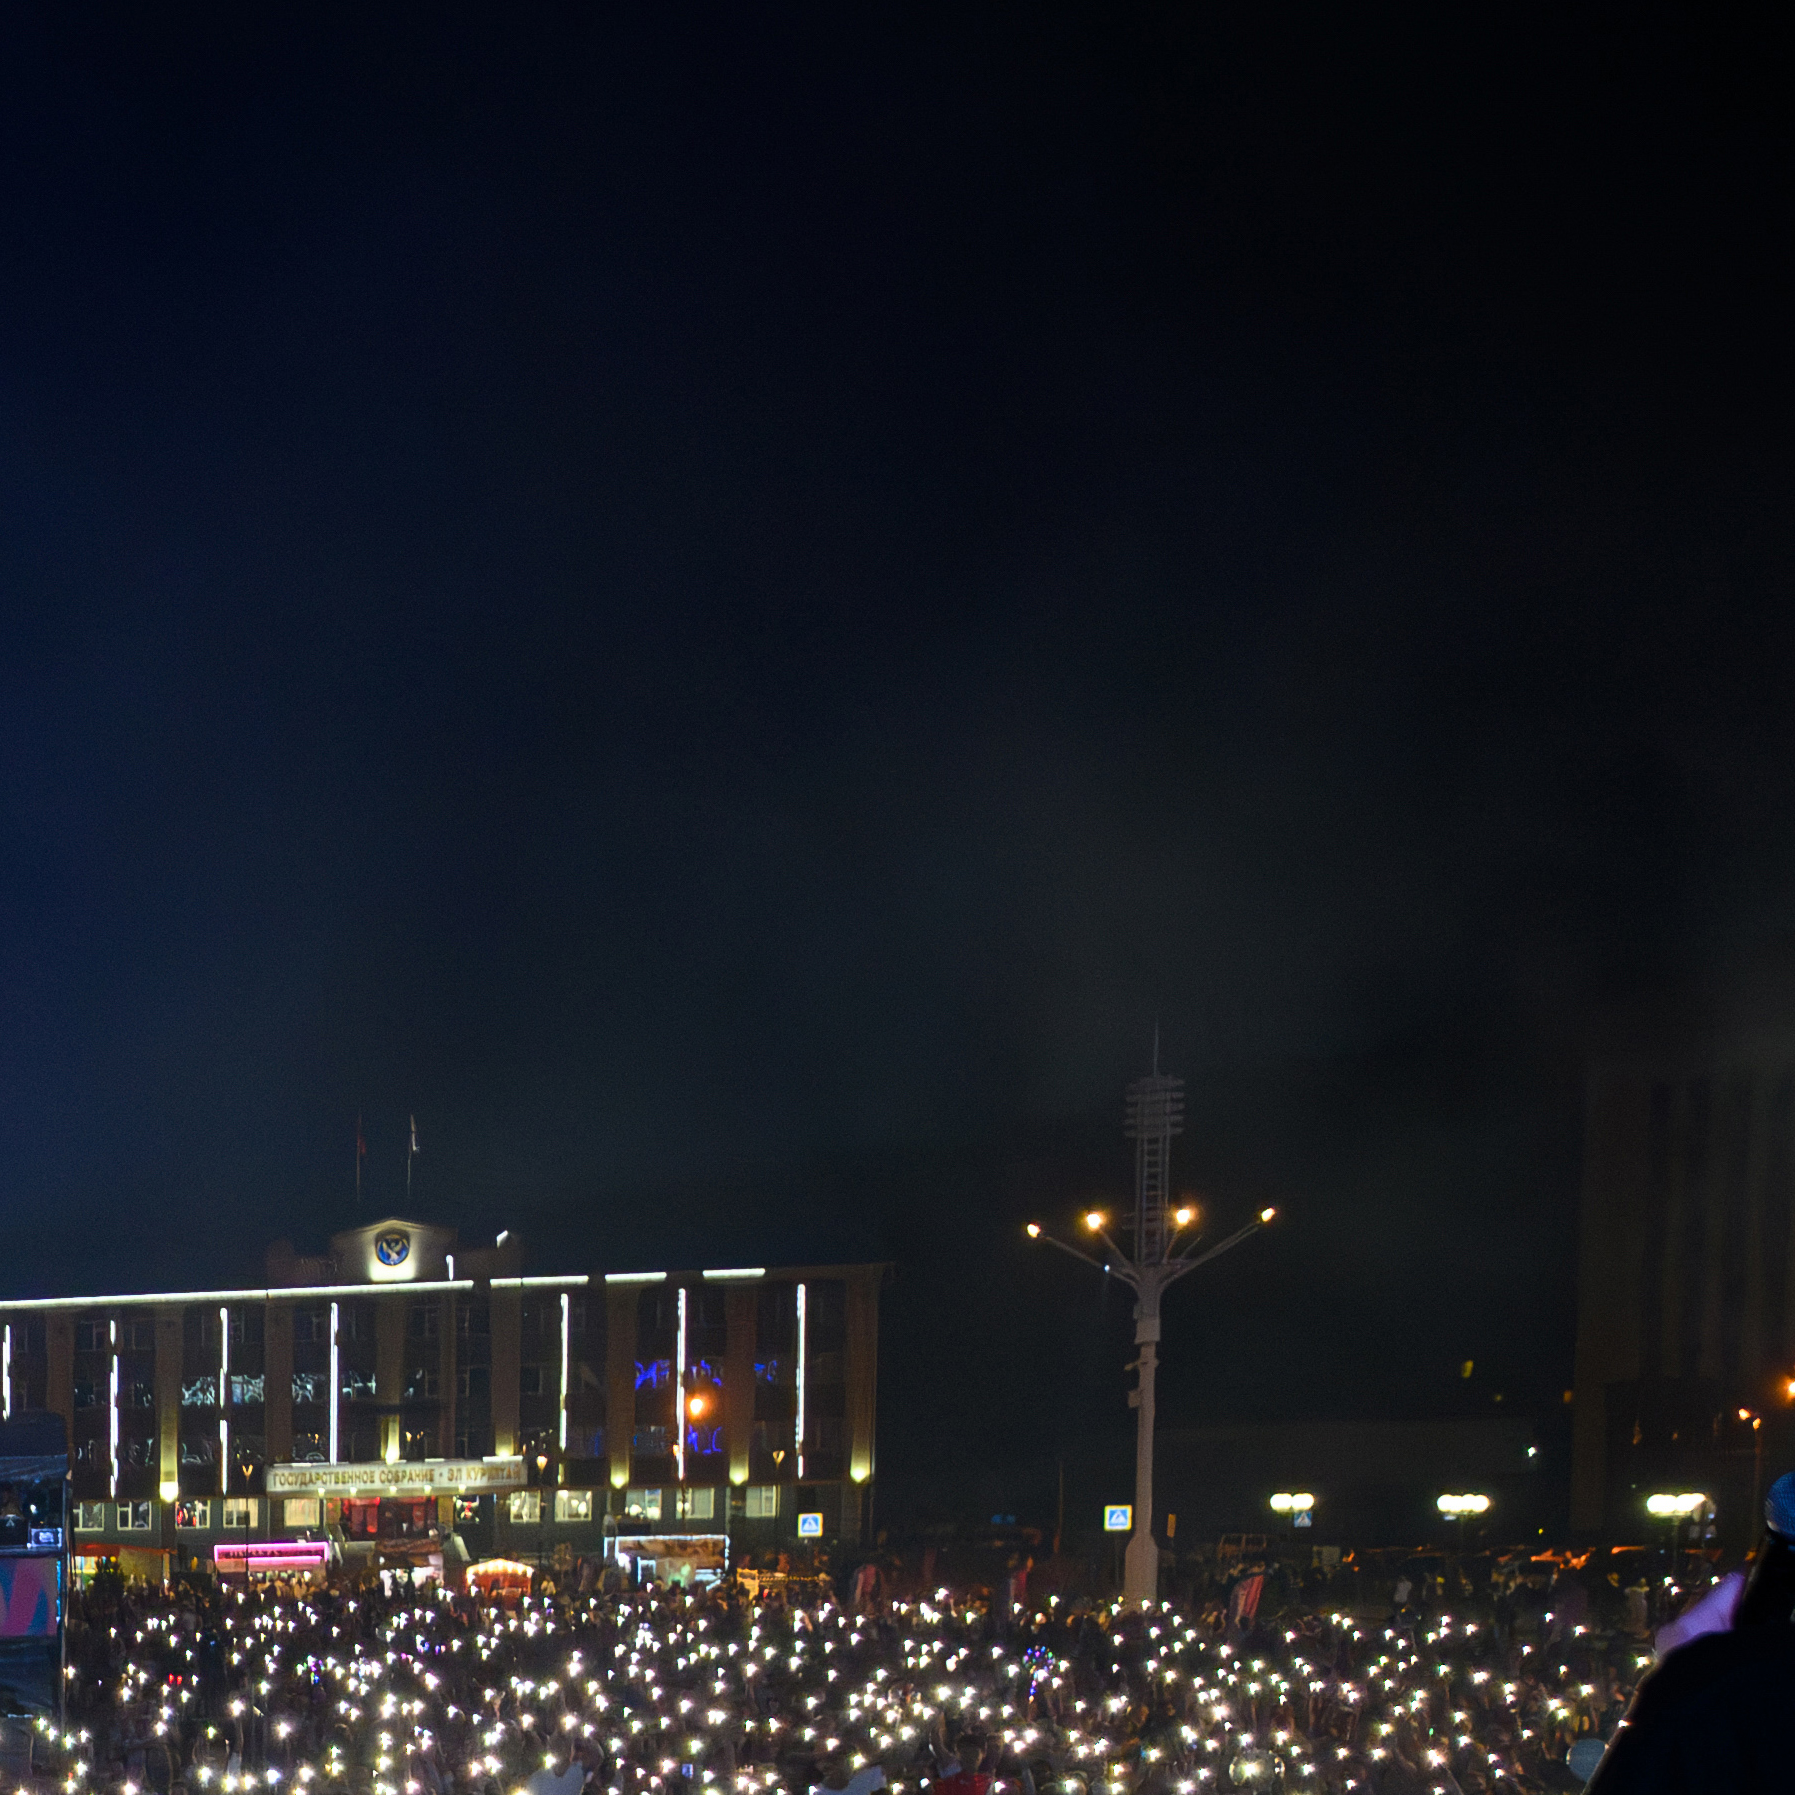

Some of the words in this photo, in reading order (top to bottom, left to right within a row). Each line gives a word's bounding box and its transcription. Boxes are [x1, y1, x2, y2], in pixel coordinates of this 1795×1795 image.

[273, 1470, 375, 1487] ГОСУДАРСТВЕННОЕ
[379, 1468, 435, 1484] СОБРАНИЕ
[447, 1467, 462, 1482] ЭЛ
